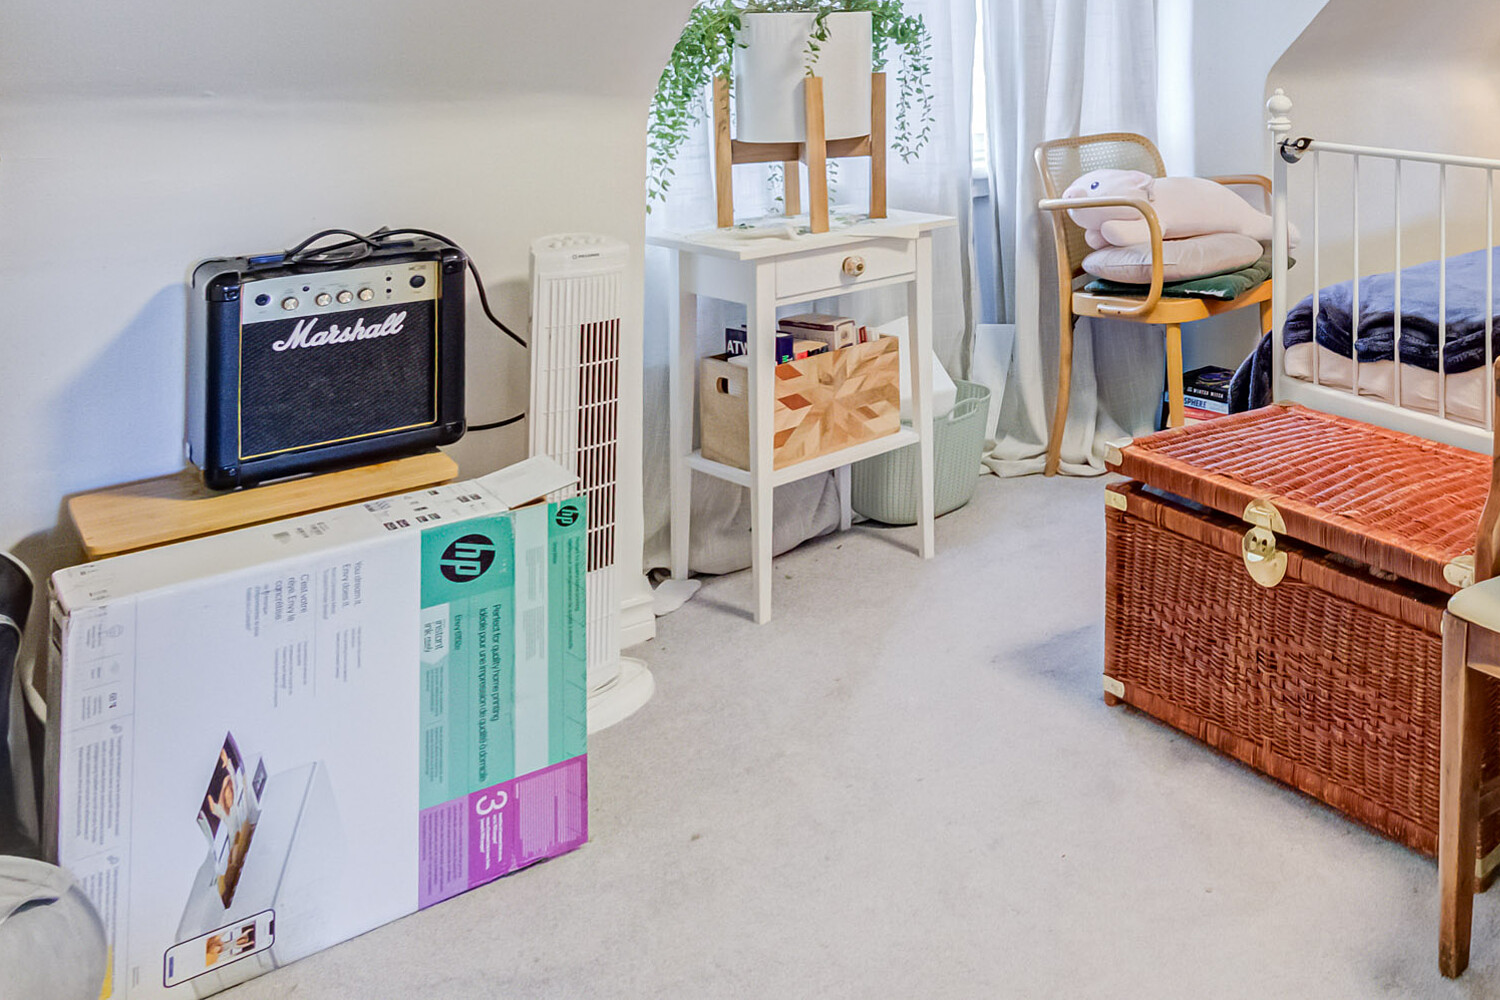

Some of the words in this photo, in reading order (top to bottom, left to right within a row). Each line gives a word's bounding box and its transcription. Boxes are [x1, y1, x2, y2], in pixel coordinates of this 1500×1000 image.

[272, 310, 408, 352] Marshall
[1184, 397, 1207, 408] SPHERE
[555, 508, 580, 525] hp
[439, 541, 498, 578] hp
[353, 576, 362, 600] dream
[286, 595, 296, 614] Envy
[299, 593, 308, 613] votre
[423, 622, 434, 637] ink
[491, 604, 502, 632] Perfect
[434, 619, 445, 651] instant
[477, 631, 488, 649] pour
[490, 644, 501, 669] quality
[477, 666, 488, 708] impression
[491, 669, 501, 692] home
[489, 692, 501, 721] printing
[477, 718, 488, 743] qualité
[478, 750, 488, 782] domicile
[475, 790, 508, 816] 3
